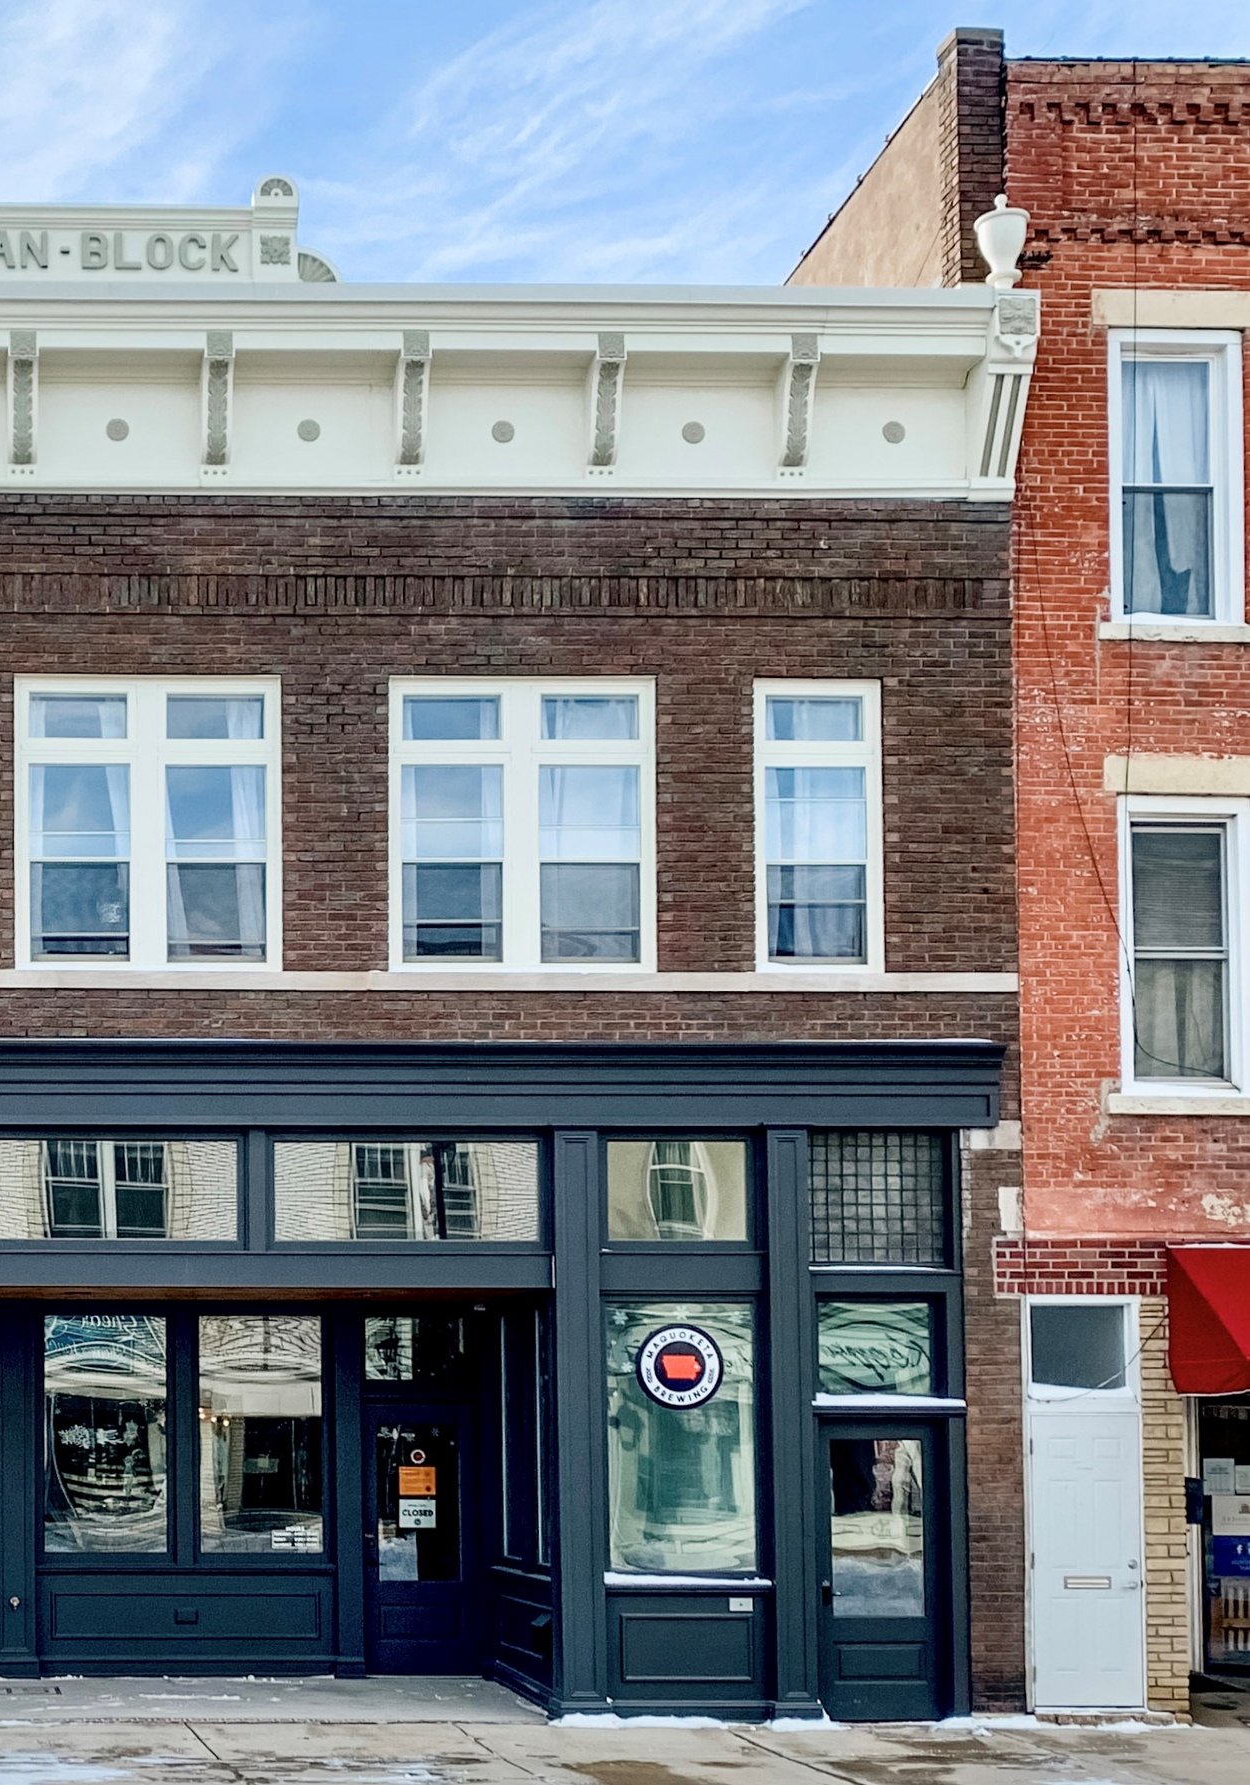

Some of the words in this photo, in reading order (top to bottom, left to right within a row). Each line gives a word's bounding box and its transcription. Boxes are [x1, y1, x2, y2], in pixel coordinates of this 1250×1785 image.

[80, 231, 240, 273] BLOCK
[646, 1331, 714, 1359] MAQUOKETA
[653, 1385, 708, 1403] BREWING
[401, 1509, 434, 1517] CLOSED
